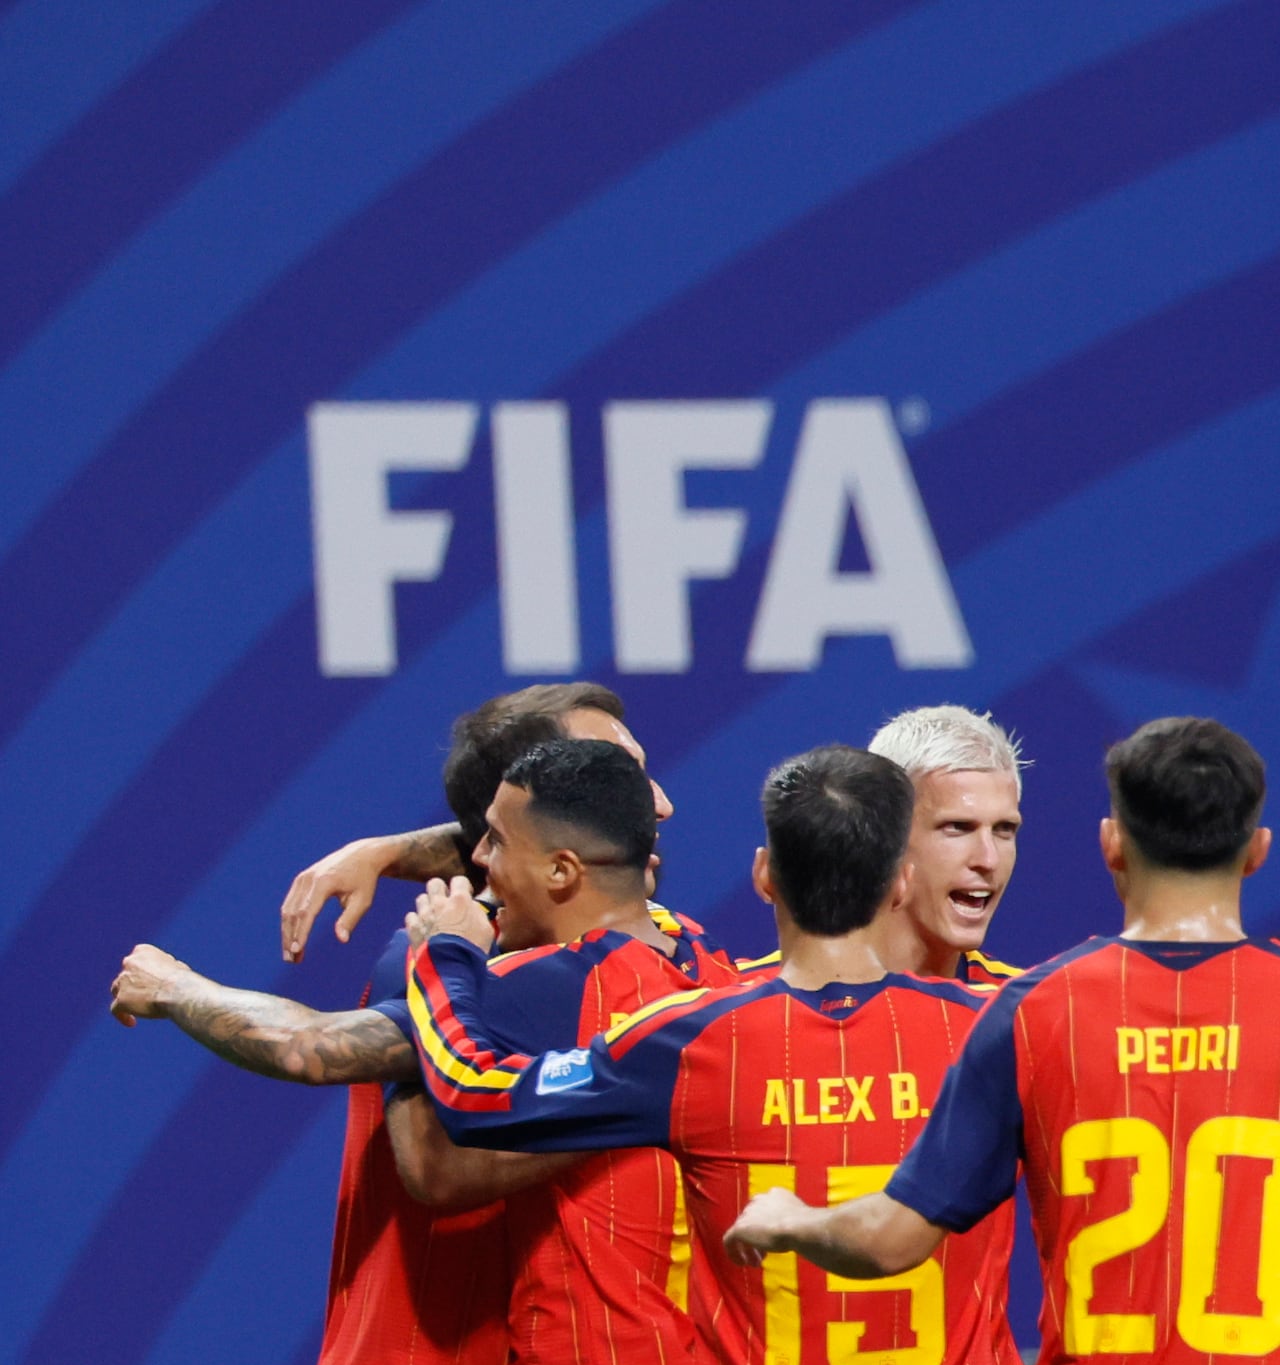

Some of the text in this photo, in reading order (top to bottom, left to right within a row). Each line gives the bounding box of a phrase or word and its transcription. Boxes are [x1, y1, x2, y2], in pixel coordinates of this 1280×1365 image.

[309, 398, 976, 677] FIFA
[1116, 1025, 1240, 1074] PEDRI
[762, 1072, 931, 1126] ALEX B.
